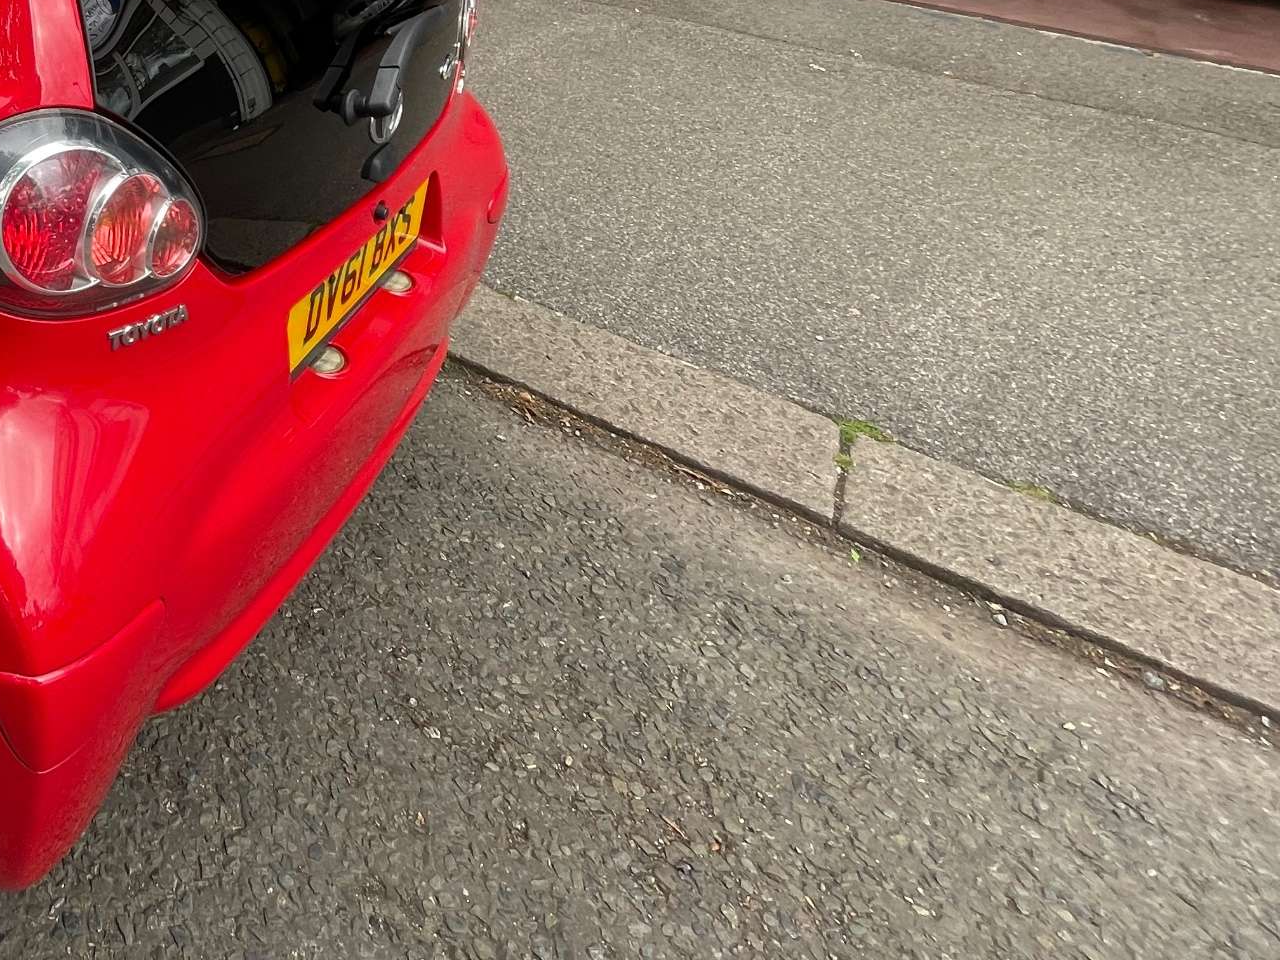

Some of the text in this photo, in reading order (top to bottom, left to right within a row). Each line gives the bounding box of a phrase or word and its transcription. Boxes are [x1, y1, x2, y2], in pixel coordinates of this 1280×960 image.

[303, 194, 417, 345] DV61 BXS
[107, 304, 189, 352] TOYOTA
